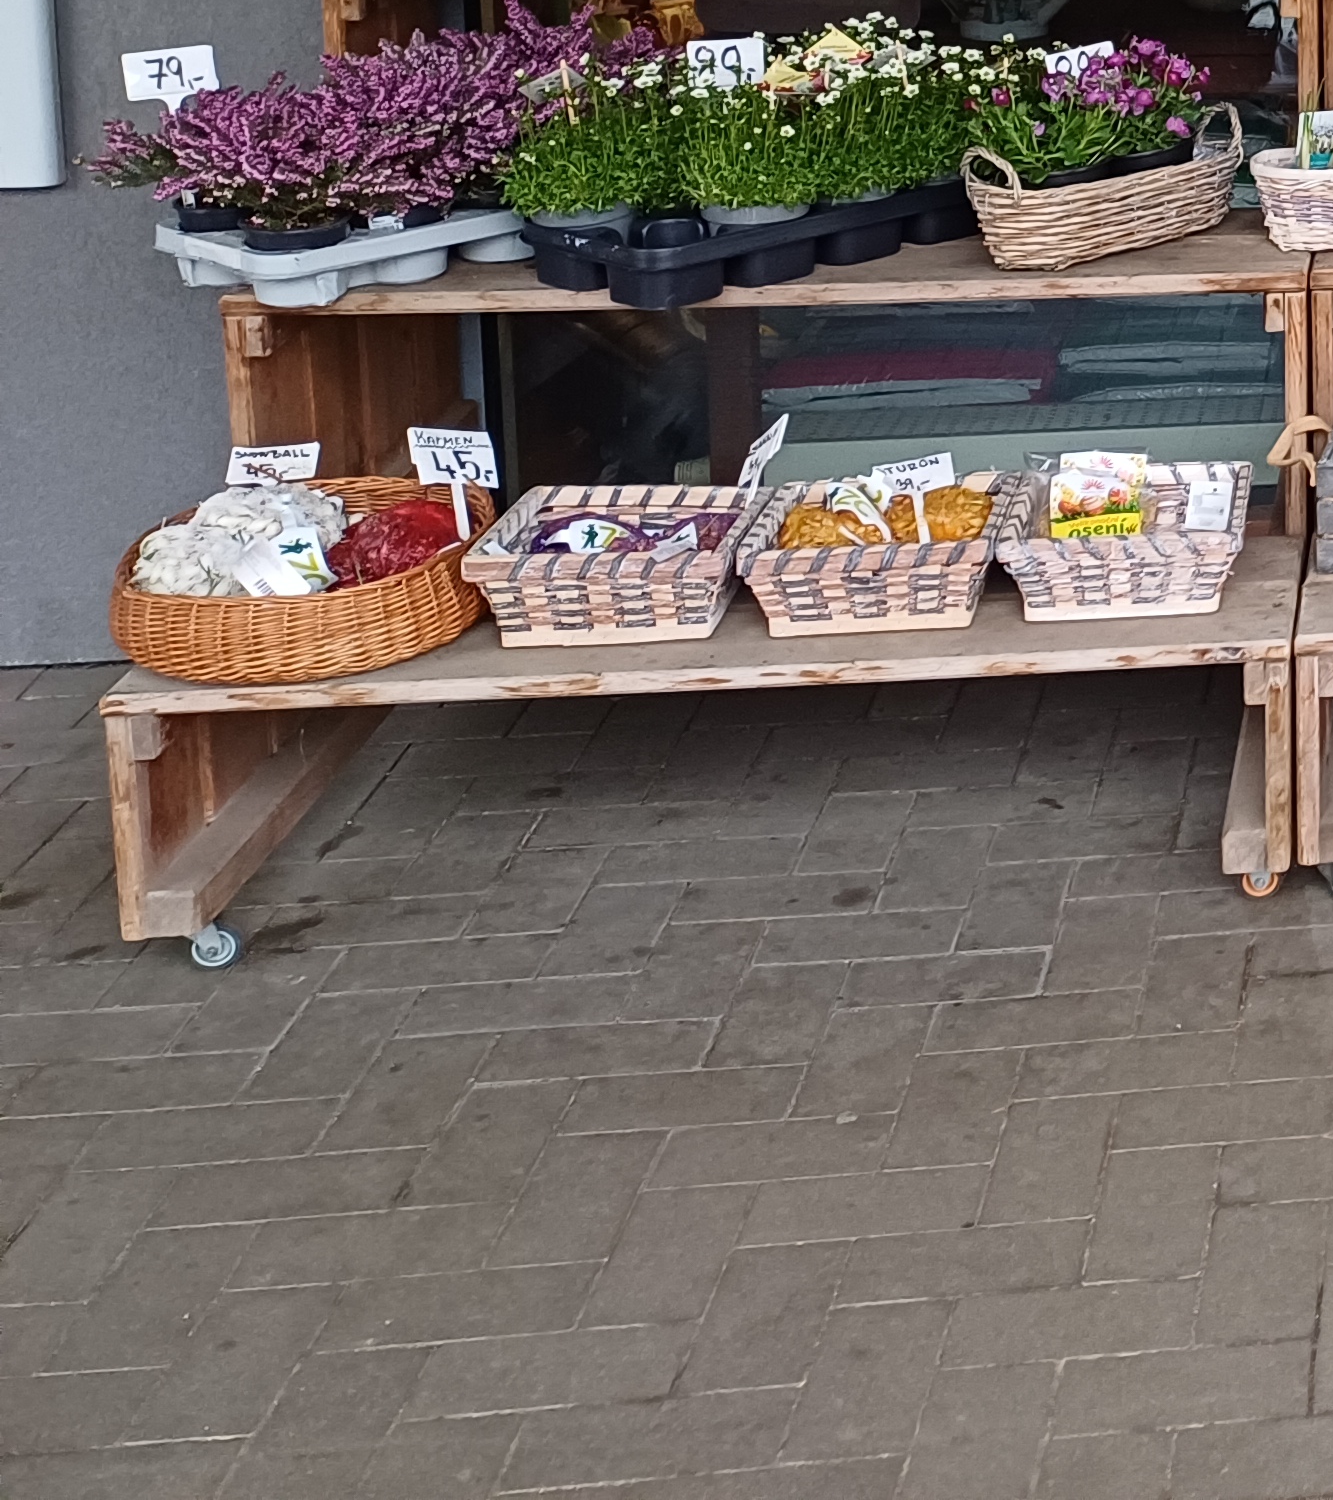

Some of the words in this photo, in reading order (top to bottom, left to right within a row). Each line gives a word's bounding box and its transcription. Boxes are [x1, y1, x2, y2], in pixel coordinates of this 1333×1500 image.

[144, 56, 204, 90] 79,-
[430, 450, 494, 483] 45,-
[1068, 517, 1127, 538] osení
